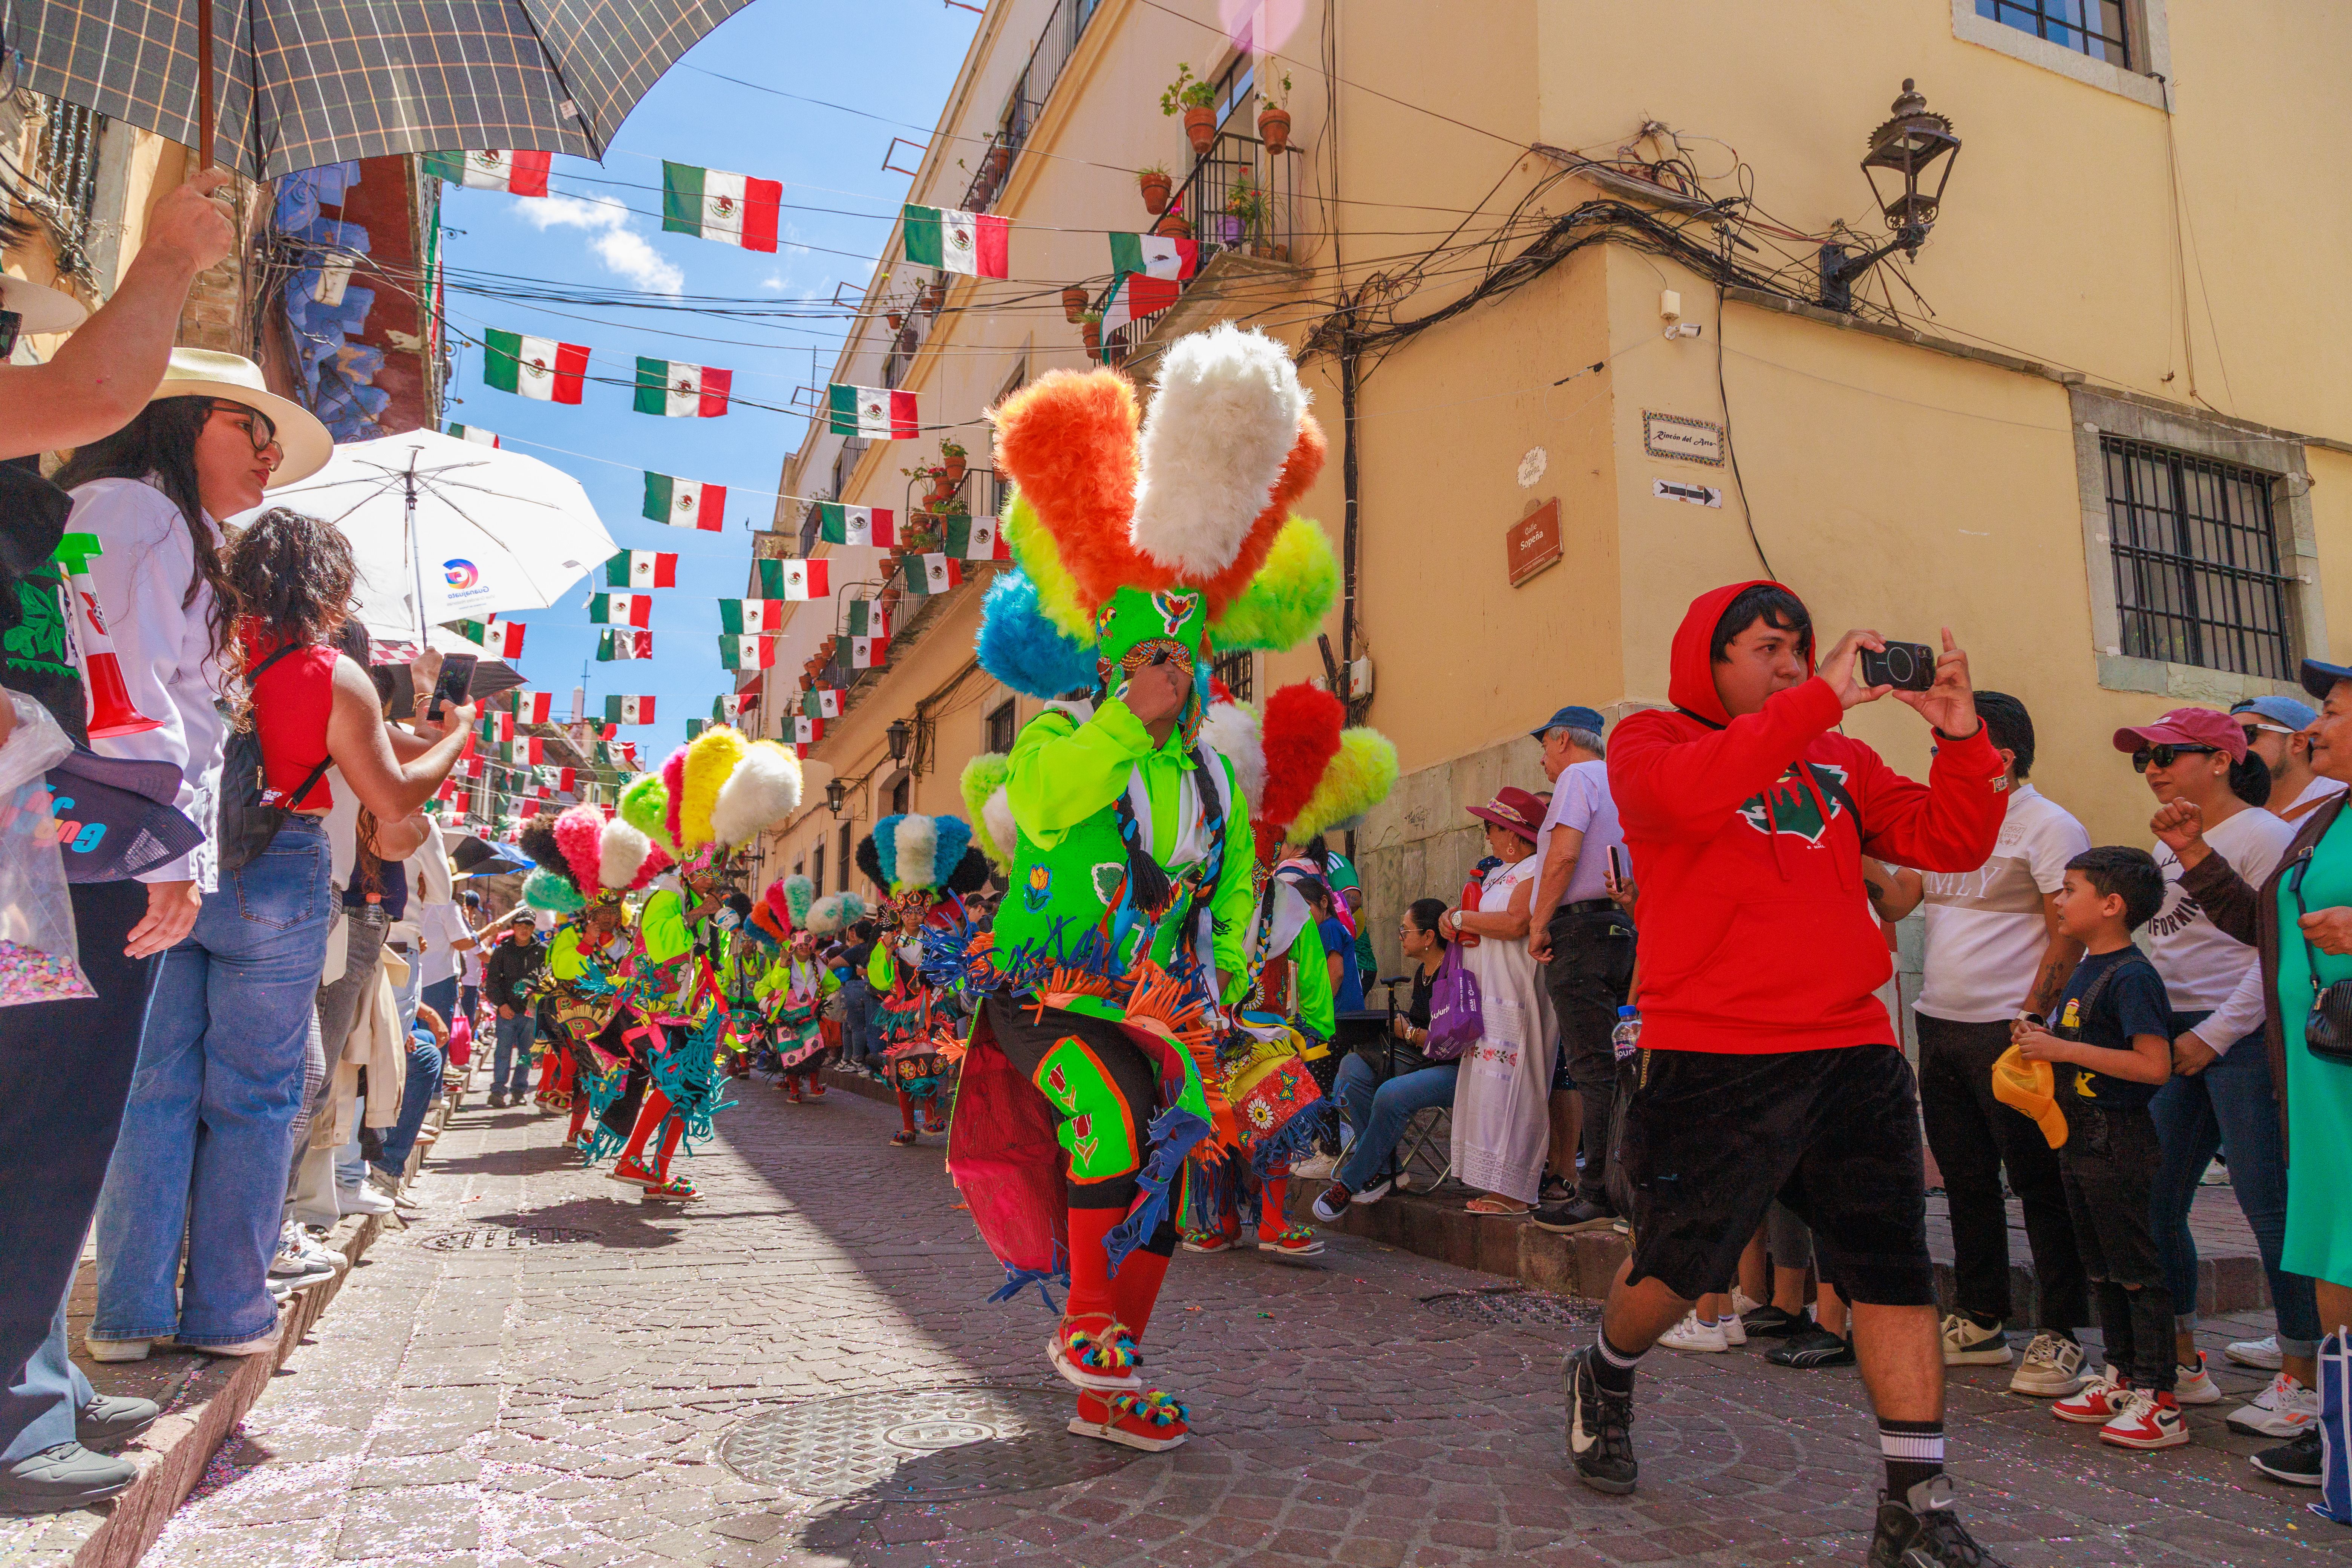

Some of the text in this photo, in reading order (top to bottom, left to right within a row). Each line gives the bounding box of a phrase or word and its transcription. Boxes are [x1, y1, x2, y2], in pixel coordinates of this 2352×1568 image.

[1652, 431, 1680, 440] Rincón
[1526, 452, 1537, 464] Calle
[1525, 523, 1537, 535] Calle
[1521, 531, 1543, 550] Sopeña
[1532, 557, 1545, 567] Histórico
[899, 1427, 983, 1441] CFE
